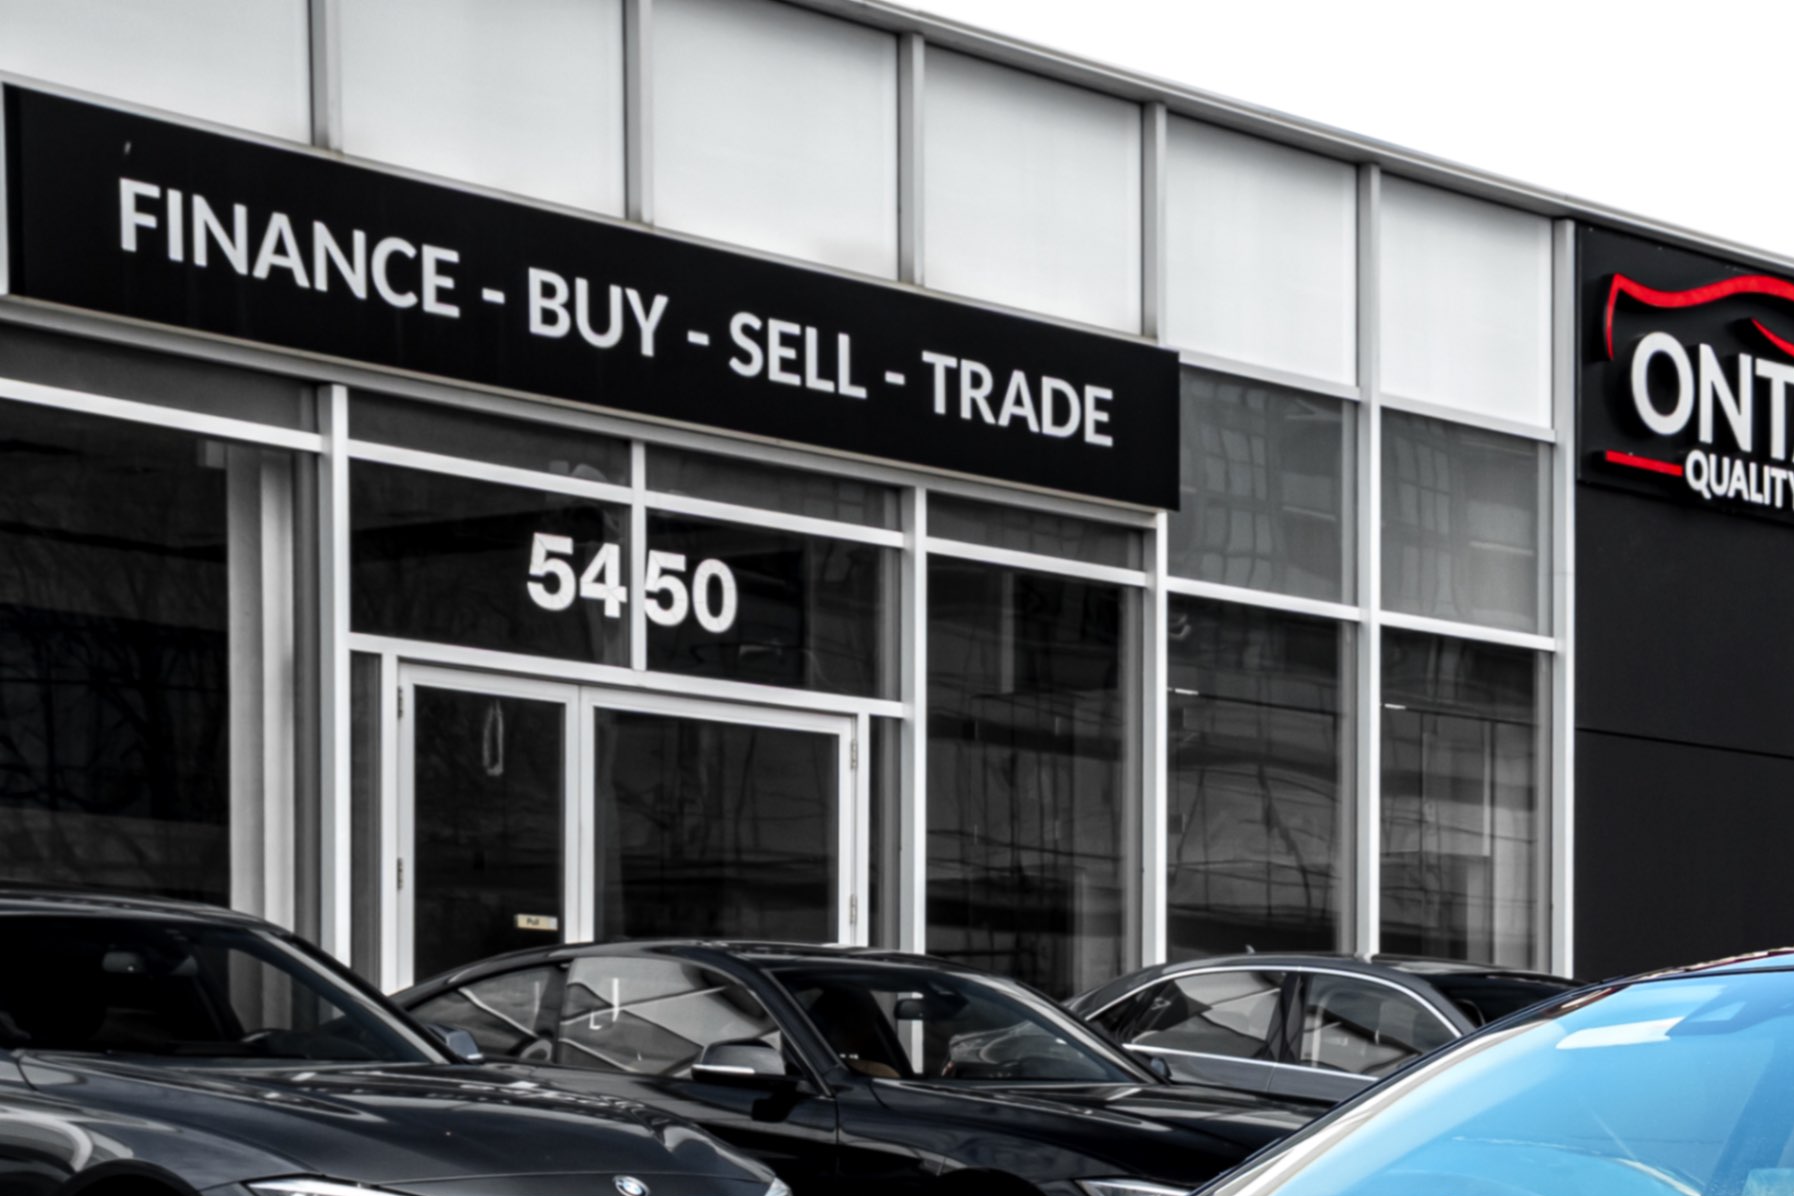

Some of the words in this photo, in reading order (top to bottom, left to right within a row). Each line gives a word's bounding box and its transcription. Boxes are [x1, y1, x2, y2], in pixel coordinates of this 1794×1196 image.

[118, 177, 461, 319] FINANCE
[527, 266, 669, 358] BUY
[728, 311, 868, 400] SELL
[921, 350, 1114, 448] TRADE
[526, 531, 738, 635] 5450
